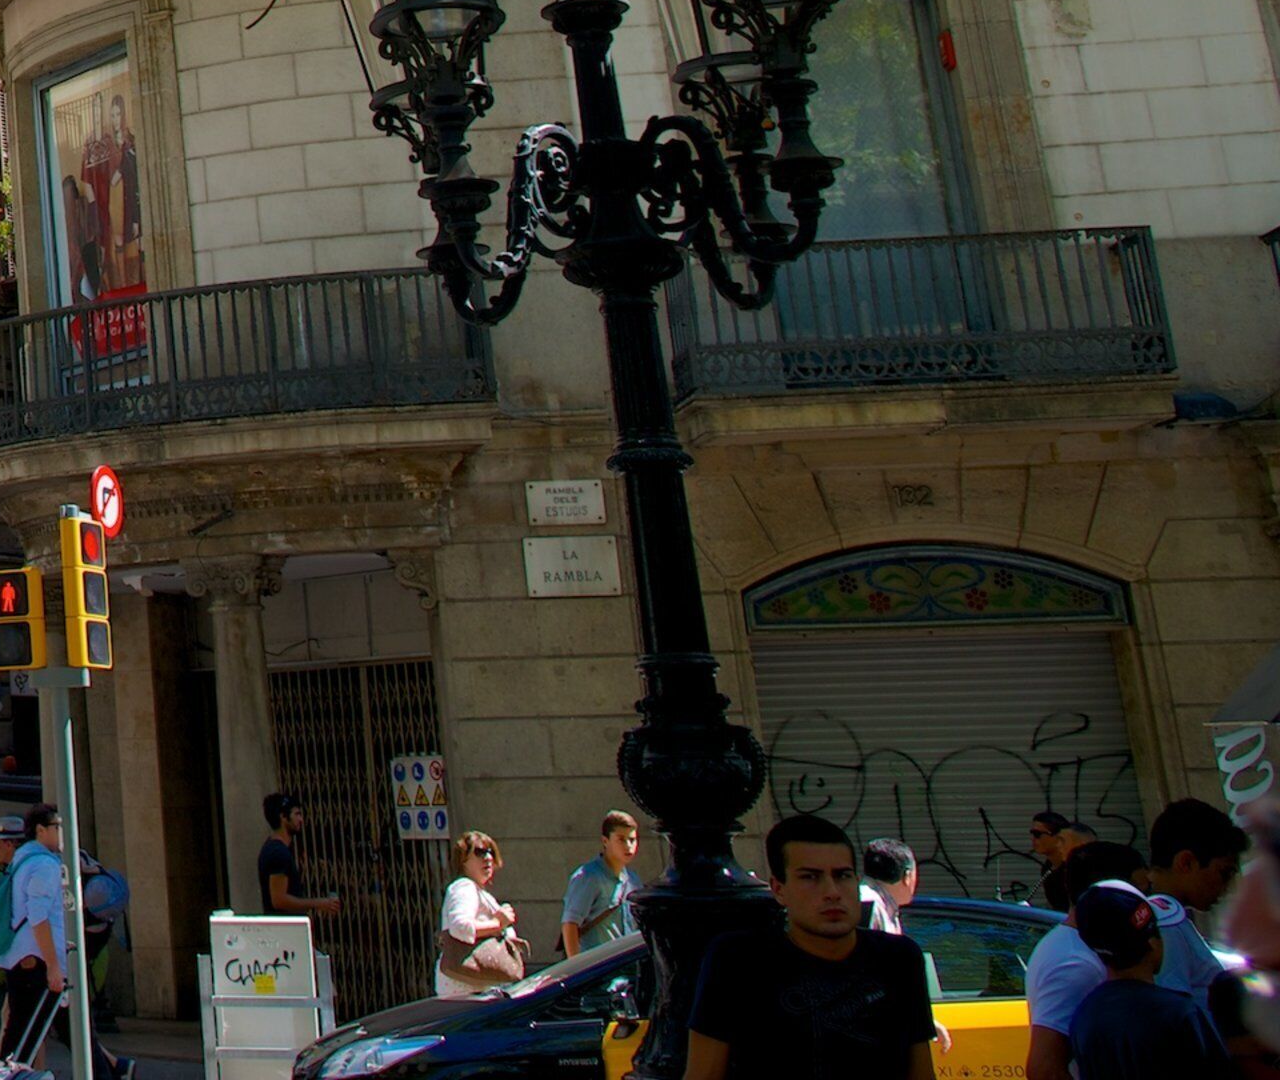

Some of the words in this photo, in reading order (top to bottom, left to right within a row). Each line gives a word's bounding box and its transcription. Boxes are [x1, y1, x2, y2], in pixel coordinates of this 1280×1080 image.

[545, 487, 584, 495] RAMBLA
[553, 496, 578, 504] DELS
[545, 505, 589, 518] ESTUDIS
[562, 550, 578, 561] LA
[543, 570, 602, 583] RAMBLA
[980, 1064, 1025, 1078] 2530
